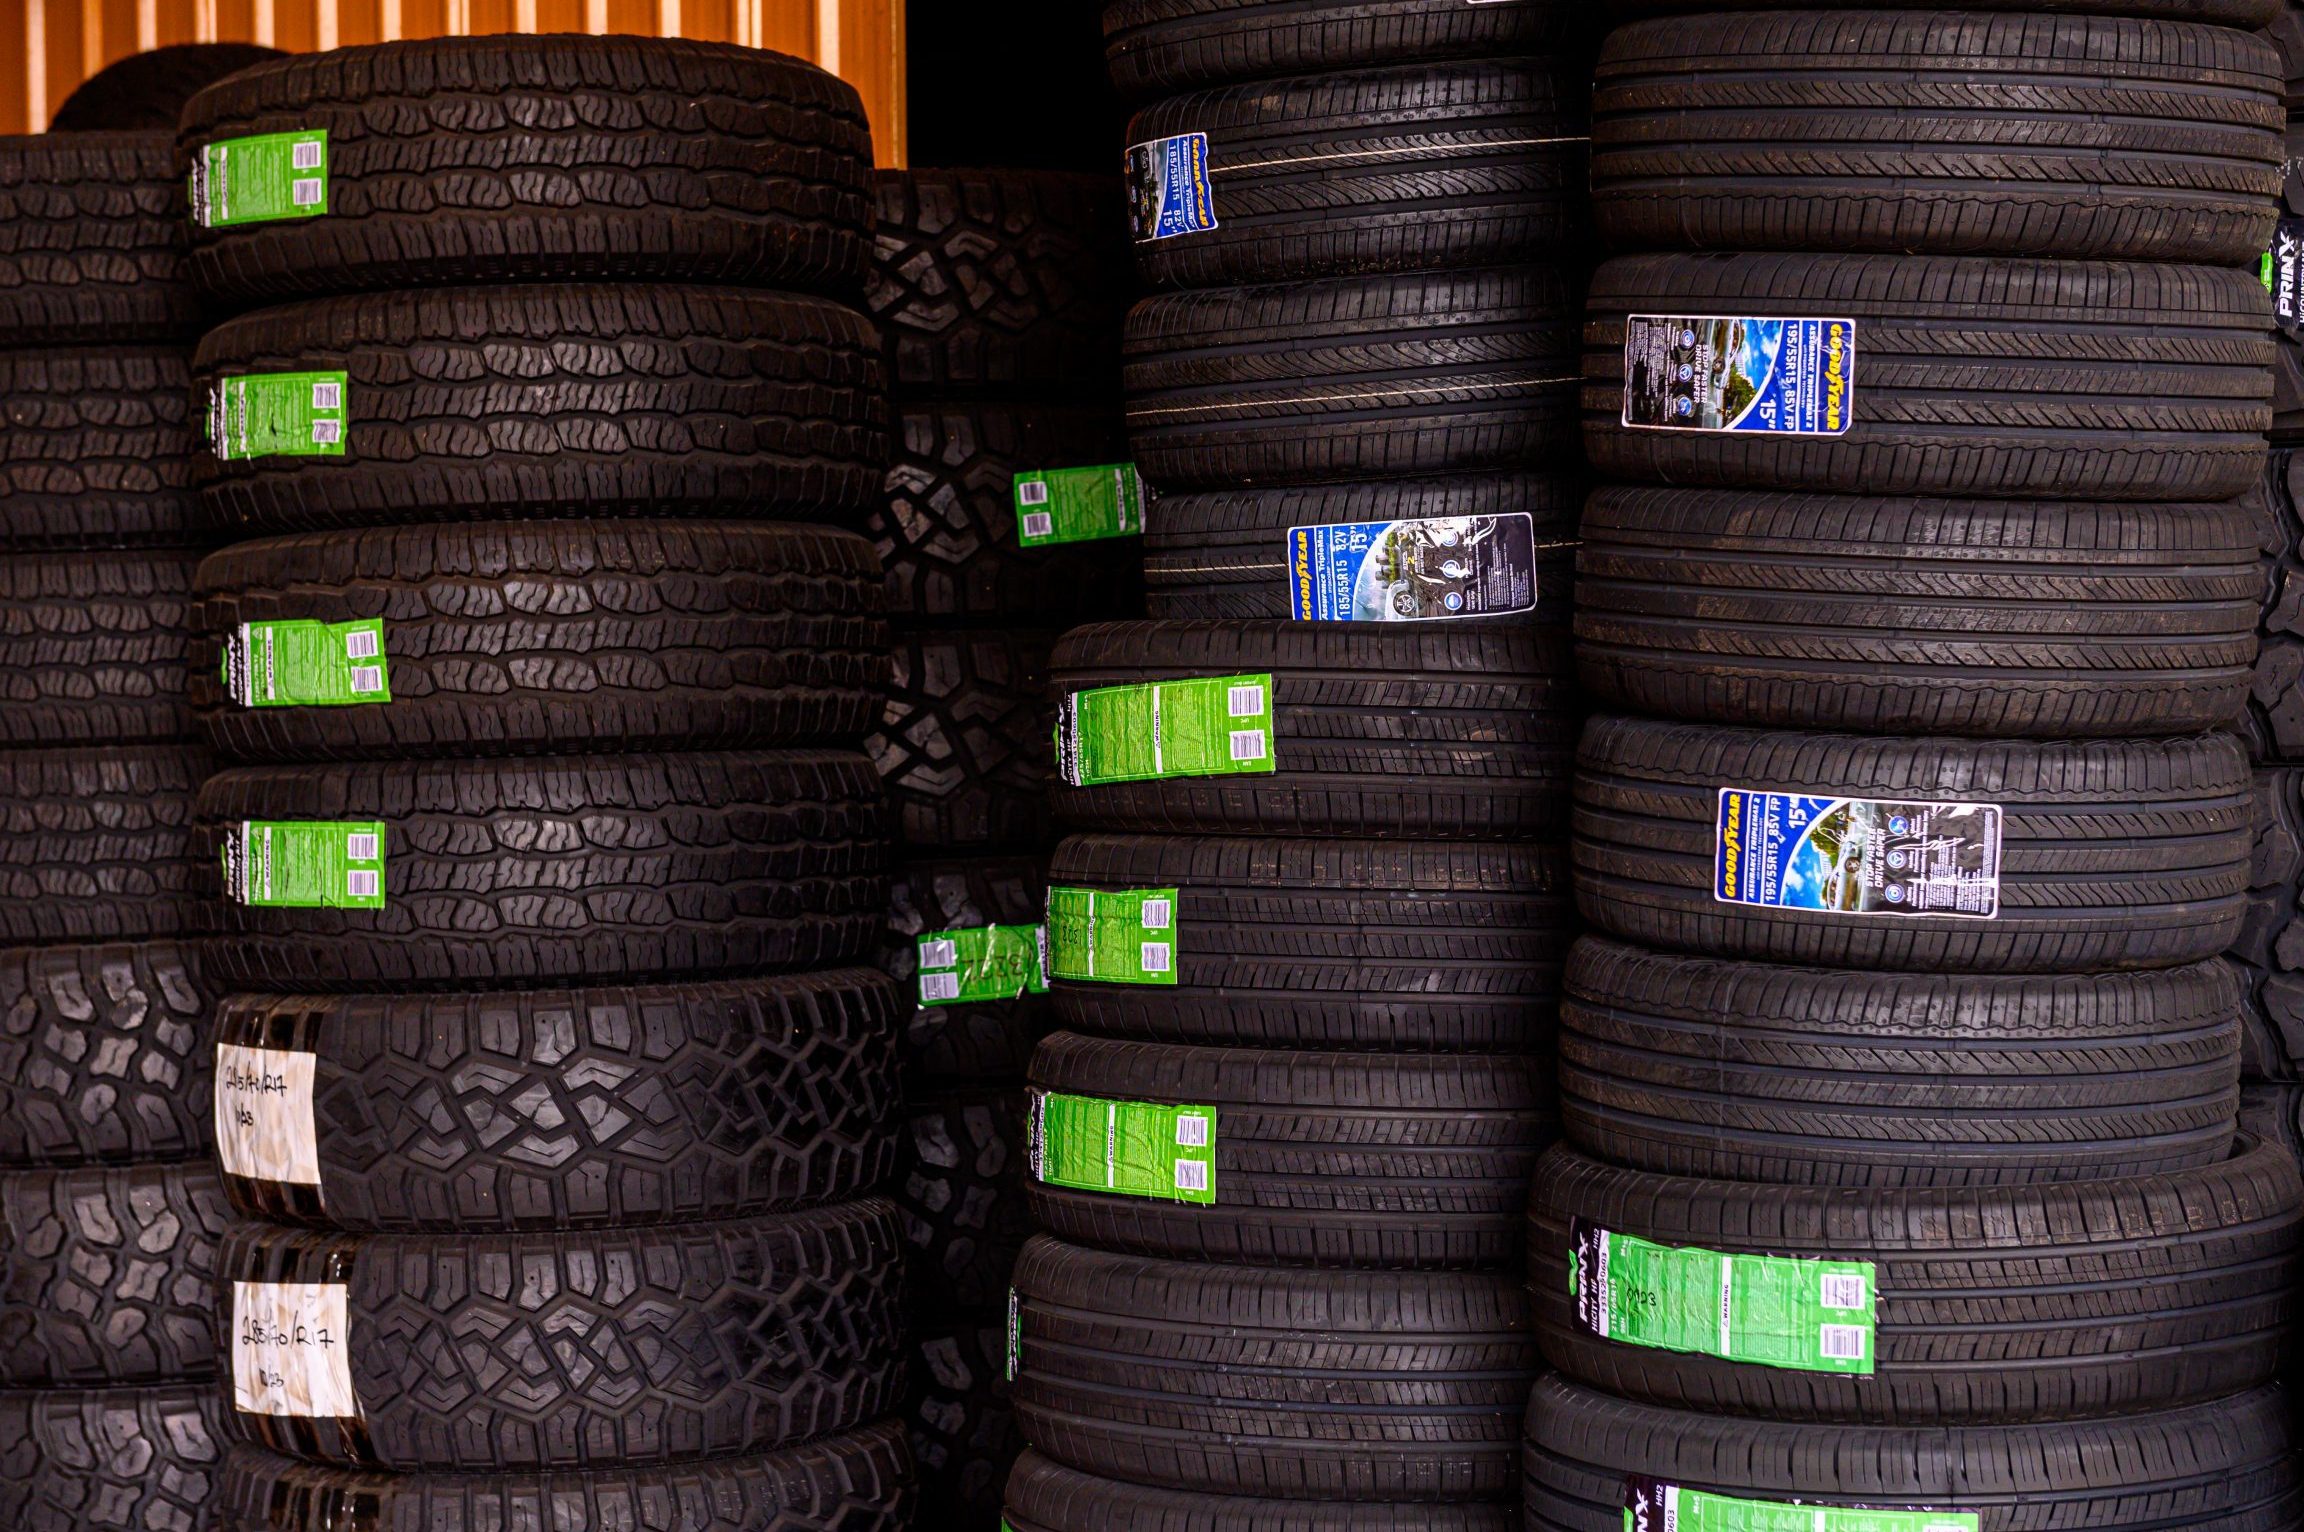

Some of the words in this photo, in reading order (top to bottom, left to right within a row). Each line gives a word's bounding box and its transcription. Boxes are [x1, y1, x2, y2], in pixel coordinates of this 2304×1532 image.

[1169, 145, 1180, 200] 185/55R15
[1173, 209, 1184, 228] 82V
[2278, 231, 2295, 317] PRINX
[1694, 344, 1702, 372] DRIVE
[1701, 344, 1709, 368] STOP
[1785, 324, 1798, 384] 195/55R15
[1807, 324, 1816, 372] ASSURANCE
[1693, 374, 1701, 403] SAFER
[1825, 324, 1844, 430] GOODYEAR
[1784, 390, 1796, 412] 85V
[1784, 416, 1794, 429] FP
[1334, 531, 1347, 550] 82V
[1297, 531, 1312, 620] GOODYEAR
[1408, 556, 1414, 564] 2
[1320, 573, 1328, 620] Assurance
[1335, 560, 1351, 616] 185/55R15
[1770, 797, 1781, 811] FP
[1750, 805, 1759, 850] TRIPLEMAX
[1768, 814, 1779, 836] 85V
[1724, 794, 1741, 898] GOODYEAR
[1866, 827, 1876, 861] FASTER
[1748, 852, 1757, 899] ASSURANCE
[1765, 842, 1778, 901] 195/55R15
[1865, 864, 1875, 887] STOP
[1875, 860, 1884, 887] DRIVE
[1577, 1231, 1588, 1323] PRINX
[1591, 1278, 1597, 1294] HP
[1655, 1484, 1663, 1507] HH2
